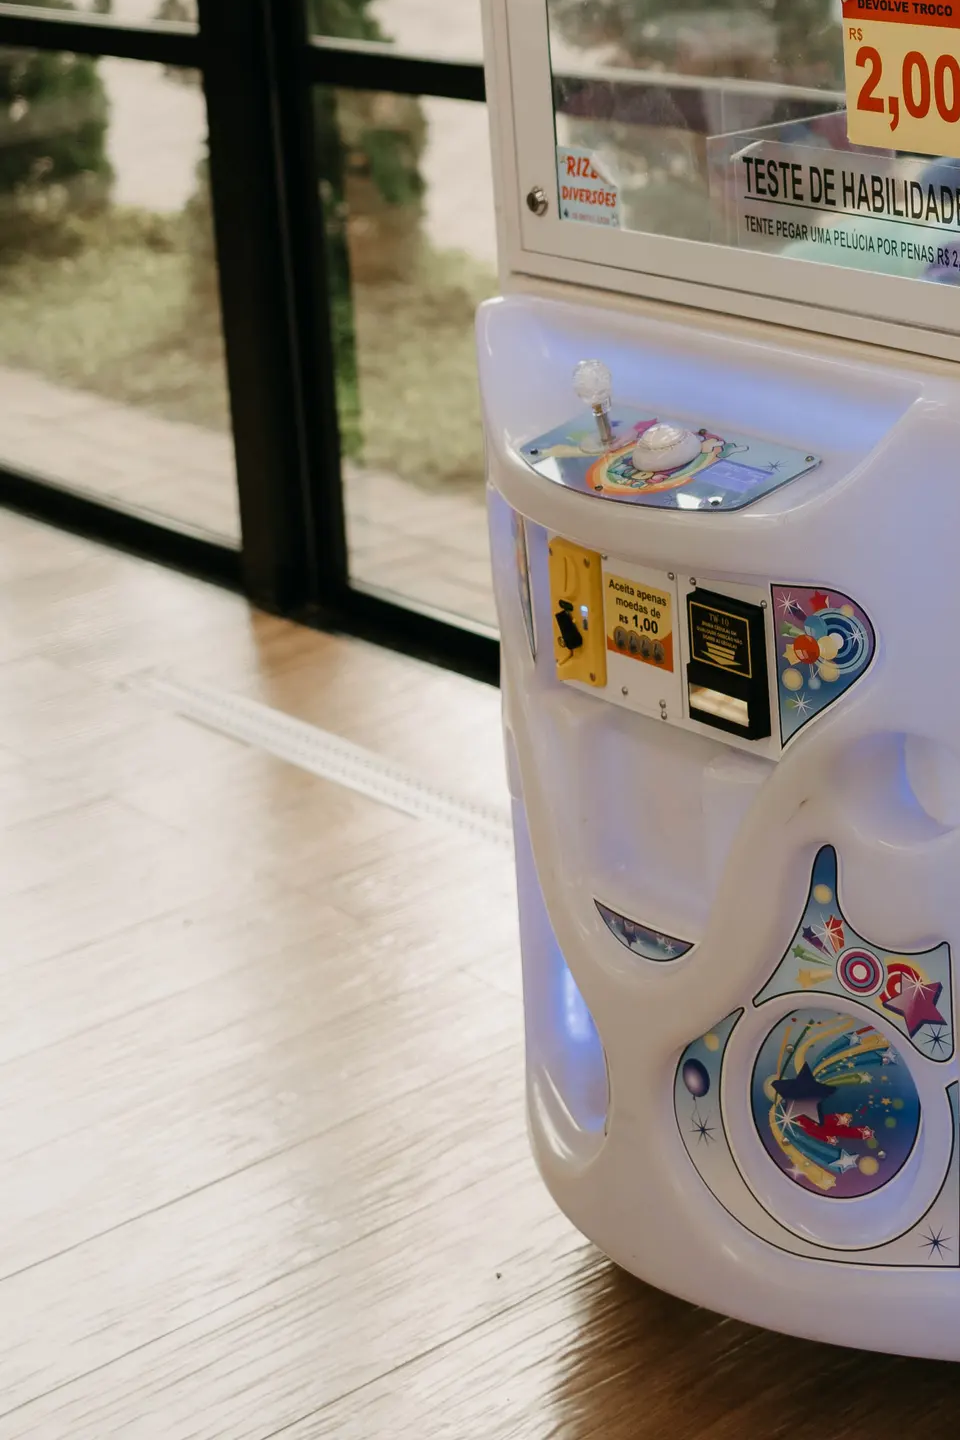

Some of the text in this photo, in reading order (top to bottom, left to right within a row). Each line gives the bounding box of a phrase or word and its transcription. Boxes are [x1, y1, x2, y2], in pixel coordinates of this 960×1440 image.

[911, 2, 953, 17] TROCO
[849, 27, 863, 41] R$
[742, 156, 804, 201] TESTE
[809, 166, 836, 206] DE
[561, 185, 617, 208] DIVERSÕES
[744, 214, 774, 235] TENTE
[776, 220, 808, 242] PEGAR
[810, 226, 831, 245] UMA
[833, 227, 876, 253] PELÚCIA
[877, 239, 898, 257] POR
[900, 242, 935, 263] PENAS
[937, 247, 950, 267] R$
[608, 579, 667, 607] Aceita apenas
[615, 597, 661, 619] moedas de
[619, 613, 659, 634] R$ 1,00
